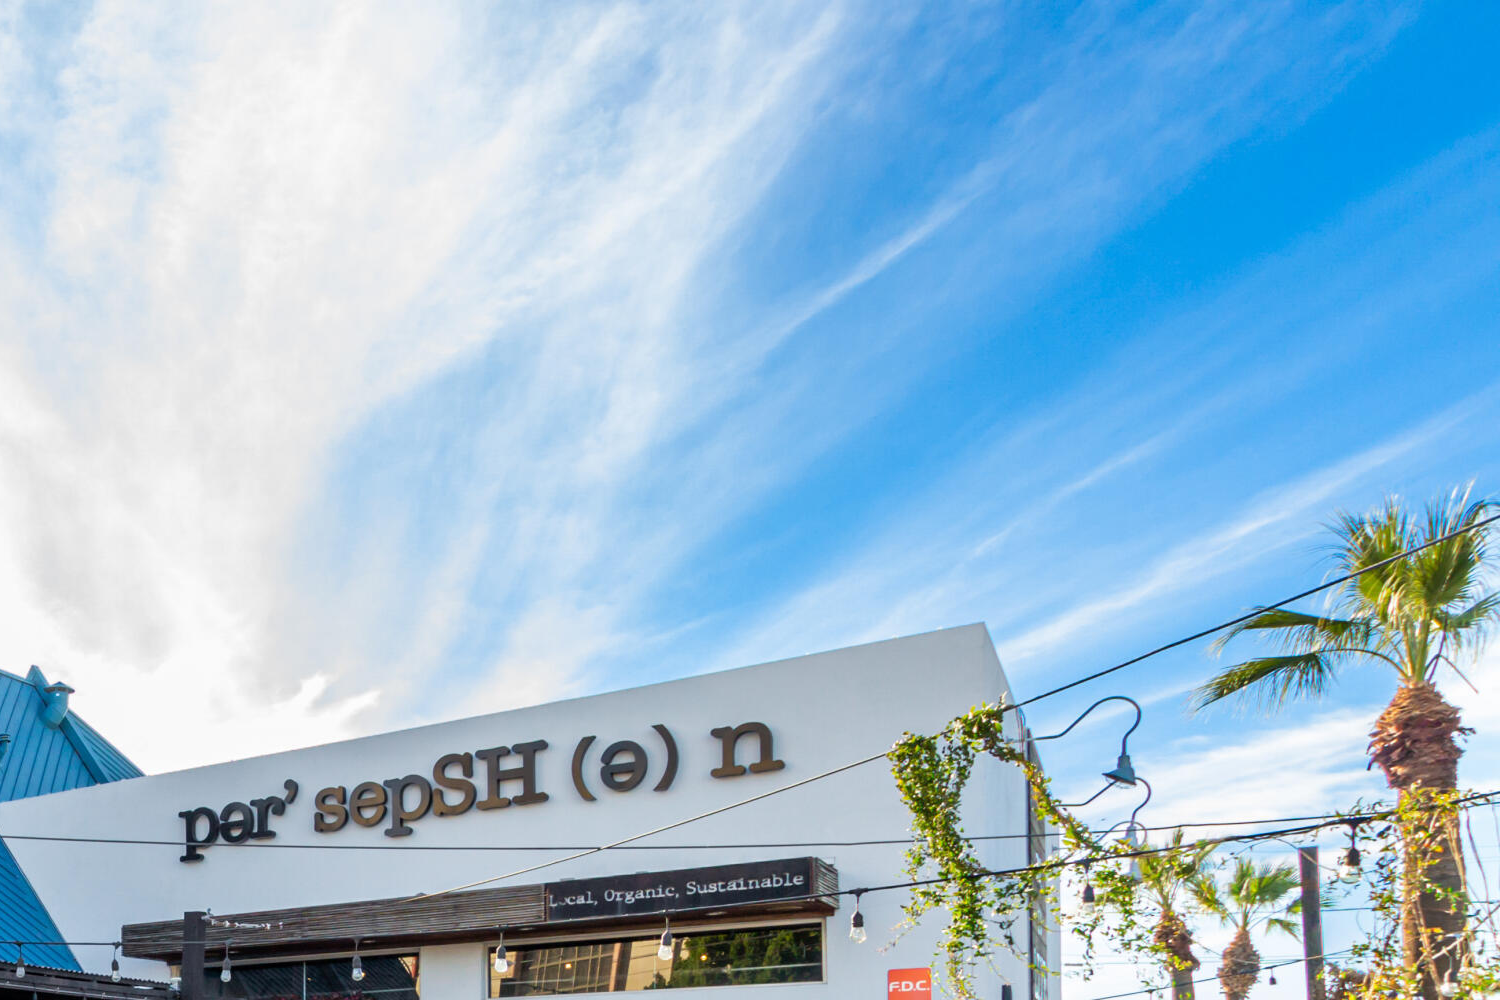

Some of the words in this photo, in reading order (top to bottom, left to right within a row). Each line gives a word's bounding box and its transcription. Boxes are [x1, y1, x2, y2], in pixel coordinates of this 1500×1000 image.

[604, 884, 680, 902] Organic,
[686, 873, 805, 895] Sustainable
[889, 980, 930, 992] F.D.C.
